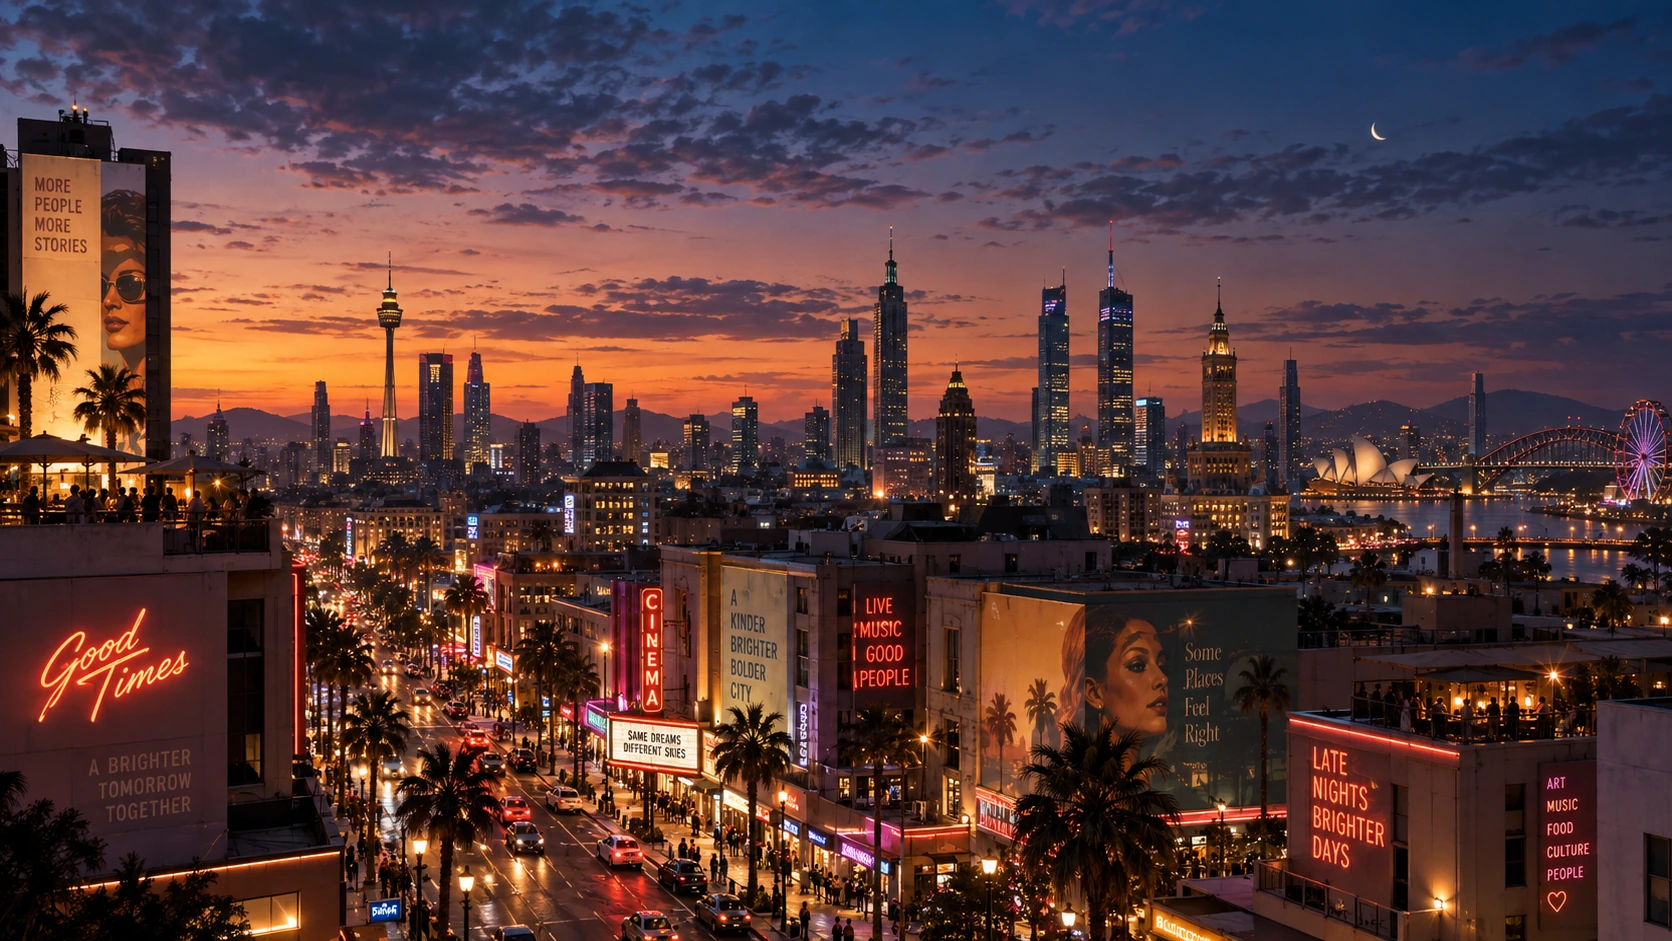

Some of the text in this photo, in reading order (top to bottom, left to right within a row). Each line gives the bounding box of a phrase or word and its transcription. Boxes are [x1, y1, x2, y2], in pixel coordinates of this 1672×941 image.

[34, 176, 71, 193] MORE
[34, 196, 82, 214] PEOPLE
[34, 217, 71, 233] MORE
[34, 236, 87, 254] STORIES
[730, 588, 738, 606] A
[866, 597, 893, 614] LIVE
[730, 612, 765, 634] KINDER
[860, 620, 902, 638] MUSIC
[645, 593, 659, 706] CINEMA
[730, 636, 778, 660] BRIGHTER
[866, 644, 904, 662] GOOD
[1184, 642, 1222, 662] Some
[38, 607, 147, 722] Good
[730, 658, 767, 682] BOLDER
[76, 647, 189, 722] Times
[860, 668, 910, 688] PEOPLE
[1183, 668, 1223, 690] Places
[730, 682, 752, 702] CITY
[1184, 696, 1210, 717] Feel
[628, 729, 681, 745] SAME DREAMS
[1184, 722, 1220, 747] Right
[623, 742, 662, 756] DIFFERENT
[88, 748, 191, 777] A BRIGHTER
[1313, 746, 1348, 776] LATE
[98, 772, 192, 800] TOMORROW
[1547, 776, 1566, 790] ART
[1313, 776, 1368, 811] NIGHTS
[105, 796, 191, 823] TOGETHER
[1547, 798, 1578, 813] MUSIC
[1313, 805, 1385, 848] BRIGHTER
[1547, 821, 1574, 836] FOOD
[1313, 835, 1350, 868] DAYS
[1547, 842, 1590, 858] CULTURE
[1547, 866, 1585, 881] PEOPLE
